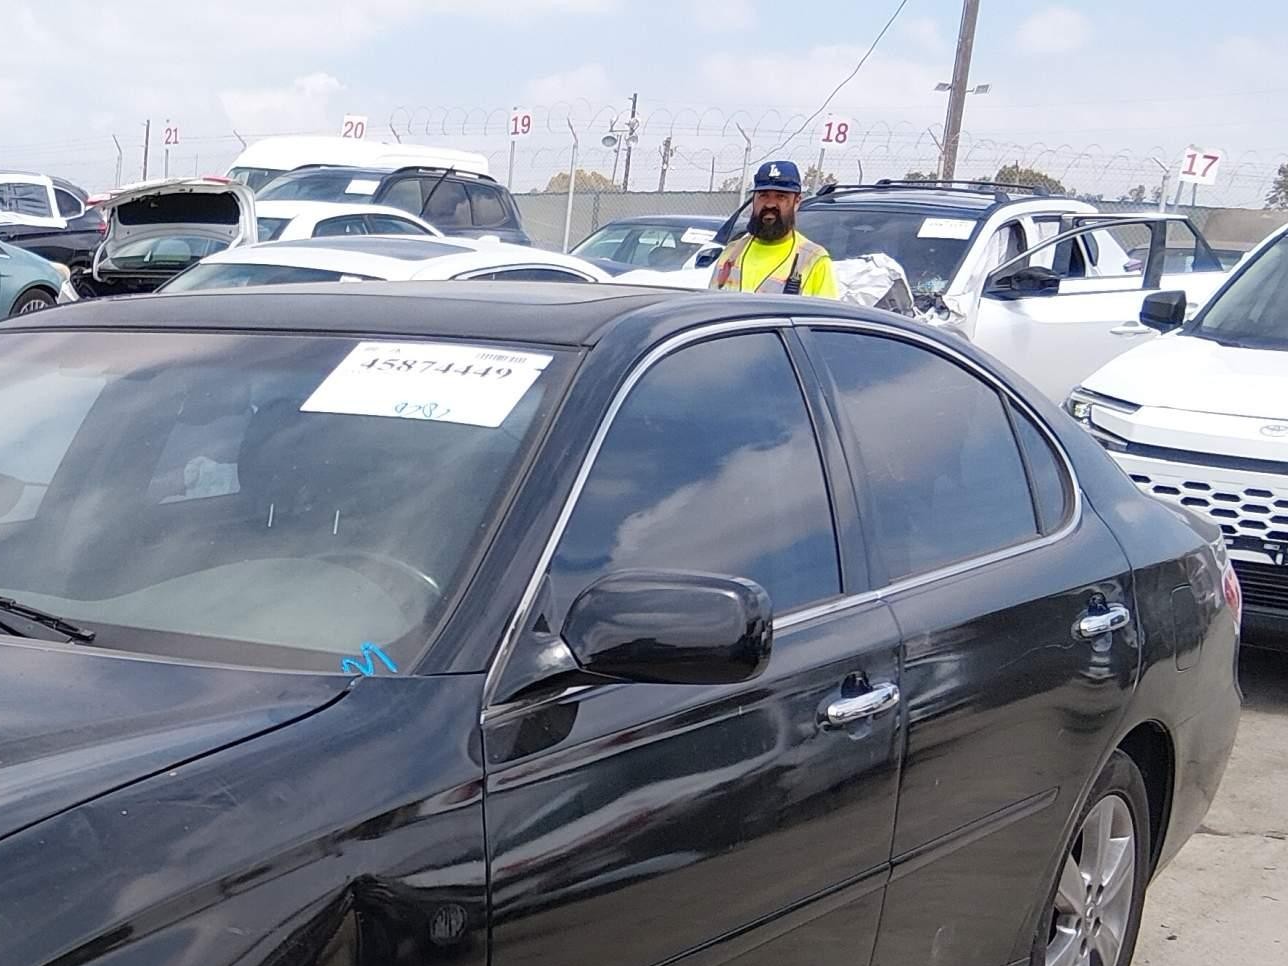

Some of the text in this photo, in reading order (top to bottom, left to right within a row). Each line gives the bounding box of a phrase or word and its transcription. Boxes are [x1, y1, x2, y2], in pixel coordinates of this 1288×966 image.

[343, 120, 365, 139] 20
[510, 114, 531, 135] 19
[822, 121, 849, 144] 18
[164, 127, 179, 145] 21
[1181, 153, 1220, 177] 17
[359, 357, 514, 379] 45874449
